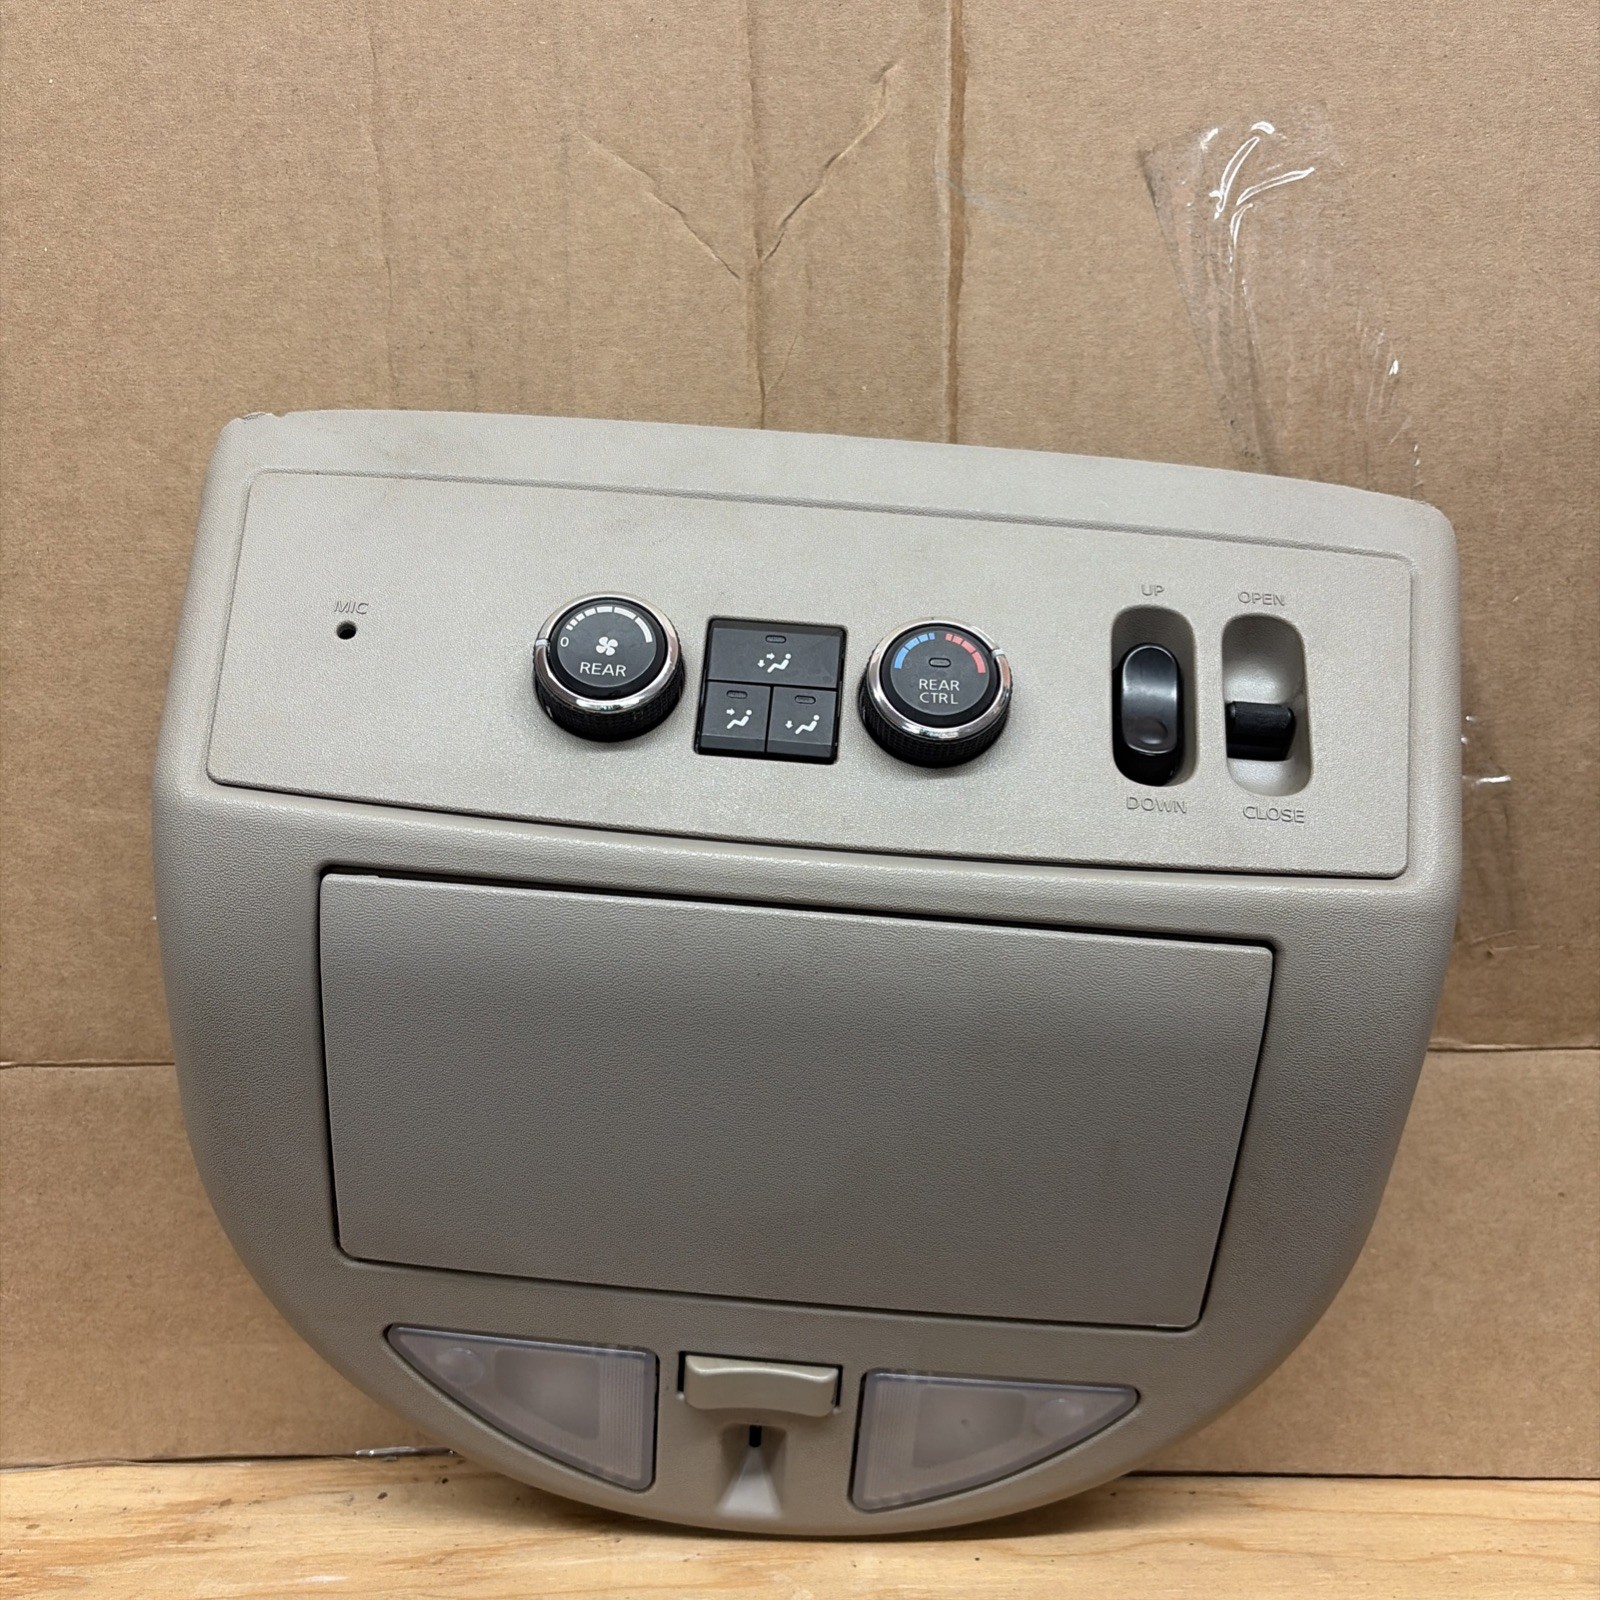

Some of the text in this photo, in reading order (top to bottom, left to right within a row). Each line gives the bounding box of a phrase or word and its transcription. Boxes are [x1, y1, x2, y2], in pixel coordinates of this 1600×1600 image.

[1140, 584, 1165, 597] UP
[1237, 591, 1286, 607] OPEN
[333, 600, 370, 615] MIC
[579, 661, 627, 678] REAR
[918, 678, 960, 692] REAR
[919, 691, 959, 705] CTRL
[1125, 796, 1187, 814] DOWN
[1242, 805, 1305, 824] CLOSE
